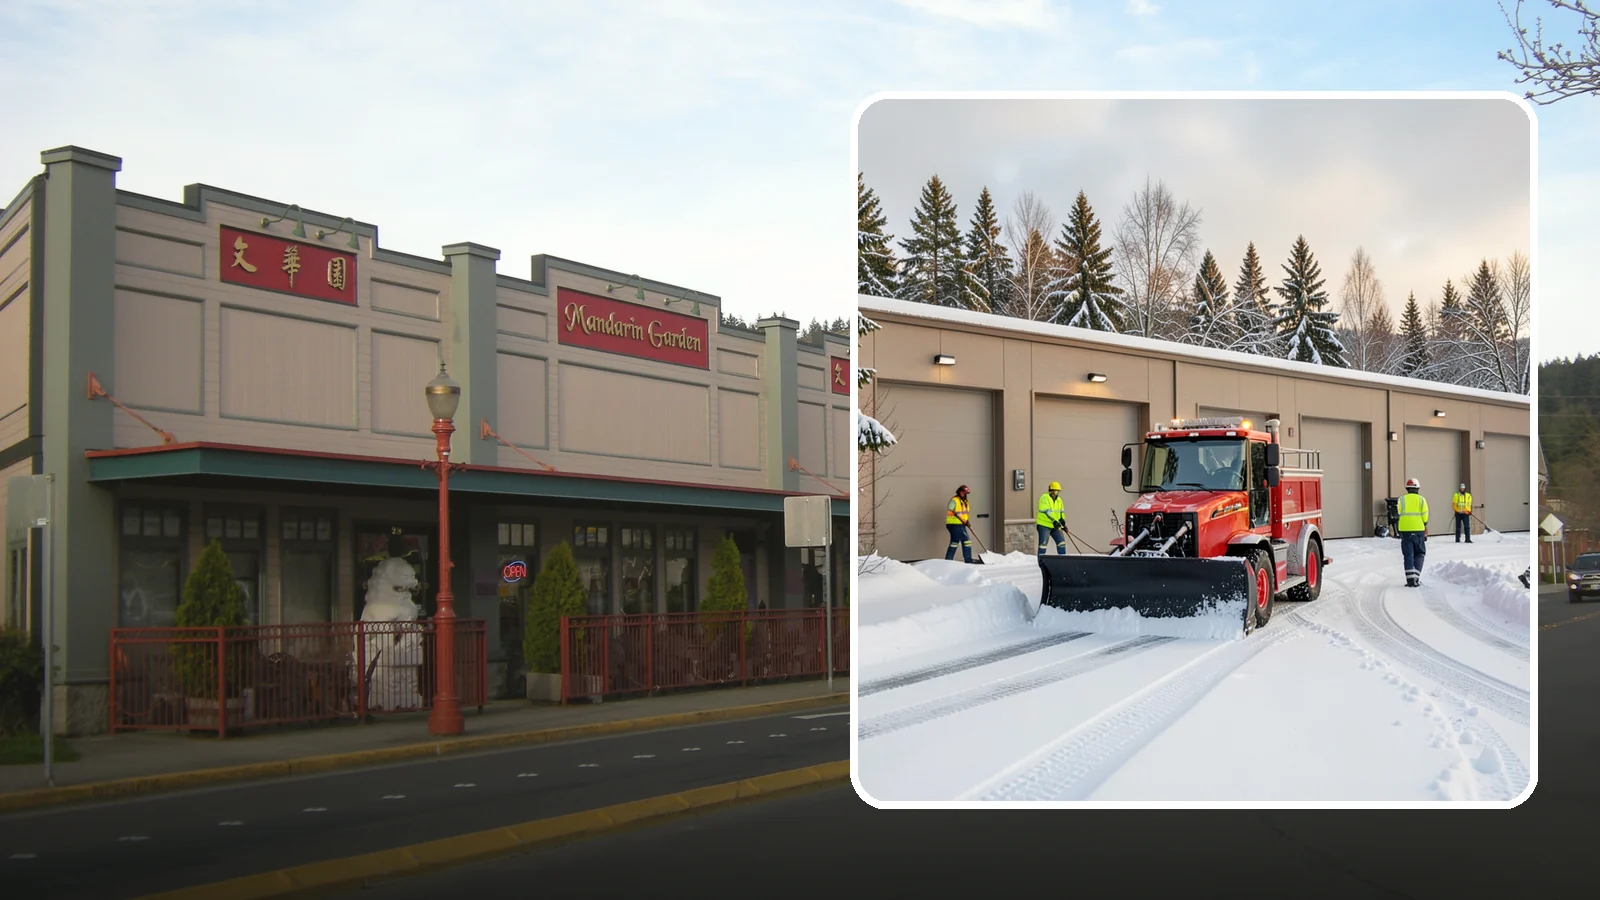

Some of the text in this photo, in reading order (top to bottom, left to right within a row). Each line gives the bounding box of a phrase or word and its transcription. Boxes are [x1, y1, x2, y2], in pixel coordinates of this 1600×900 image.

[231, 236, 346, 290] 文華園
[564, 302, 701, 352] Mandarin Garden
[503, 565, 527, 578] OPEN
